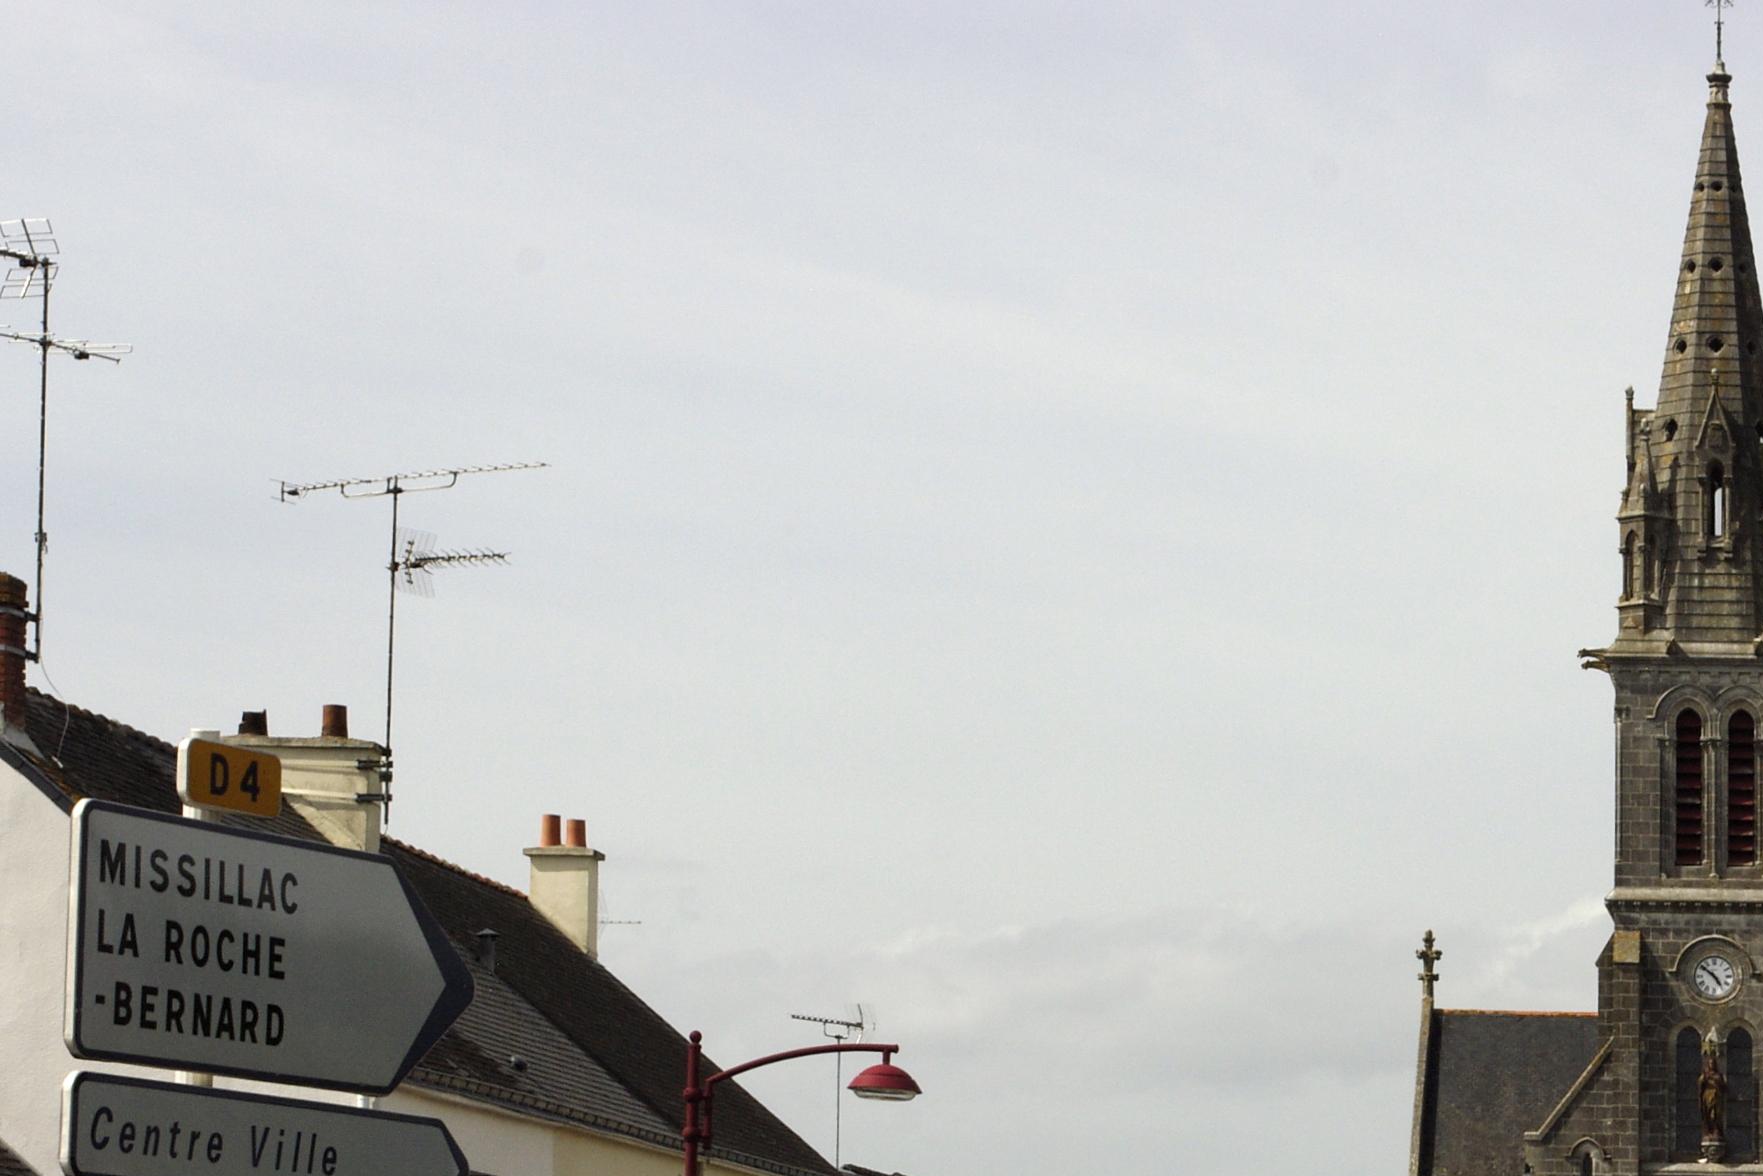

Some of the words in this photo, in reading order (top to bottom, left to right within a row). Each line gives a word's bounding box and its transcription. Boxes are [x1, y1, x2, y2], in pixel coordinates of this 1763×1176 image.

[210, 752, 229, 796] D
[240, 760, 260, 802] 4
[100, 839, 298, 914] MISSILLAC
[97, 908, 139, 958] LA
[164, 919, 286, 980] ROCHE
[95, 981, 285, 1046] -BERNARD
[90, 1106, 224, 1164] Centre
[250, 1125, 338, 1176] Ville
